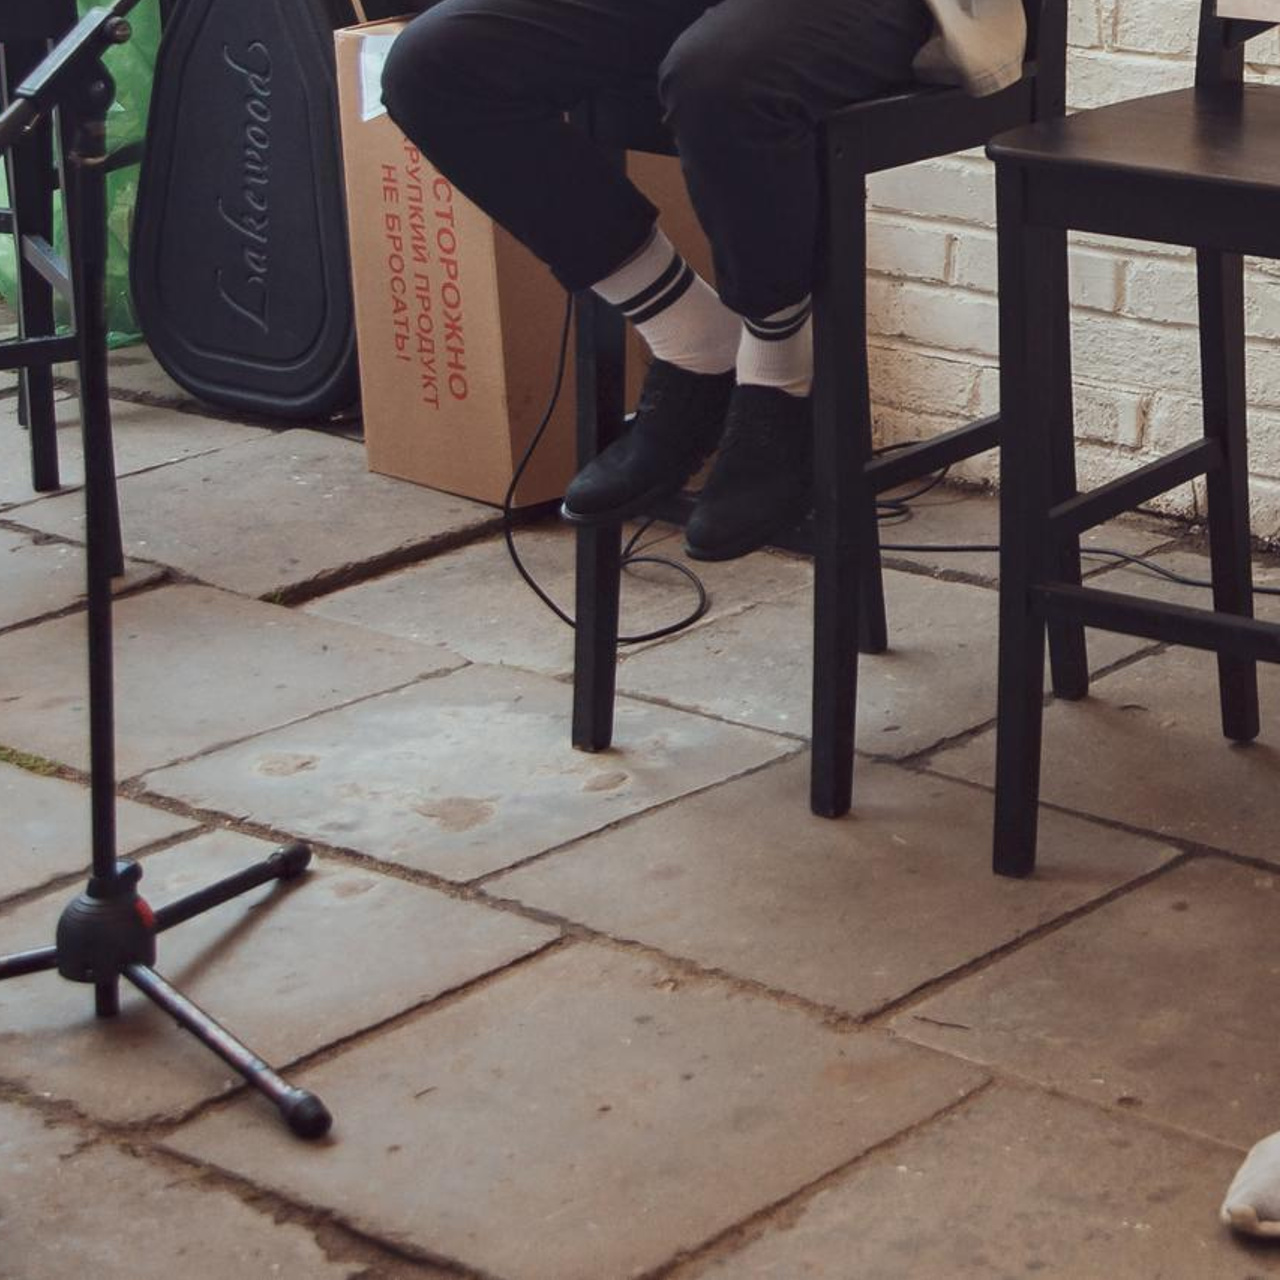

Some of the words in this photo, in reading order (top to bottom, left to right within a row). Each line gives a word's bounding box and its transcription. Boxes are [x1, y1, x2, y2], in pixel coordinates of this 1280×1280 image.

[216, 40, 273, 333] Lakewood
[381, 163, 399, 202] НЕ
[403, 137, 431, 264] РУПКИЙ
[384, 213, 412, 362] БРОСАТЬ!
[414, 272, 440, 411] ПРОДУКТ
[431, 177, 469, 401] СТОРОЖНО
